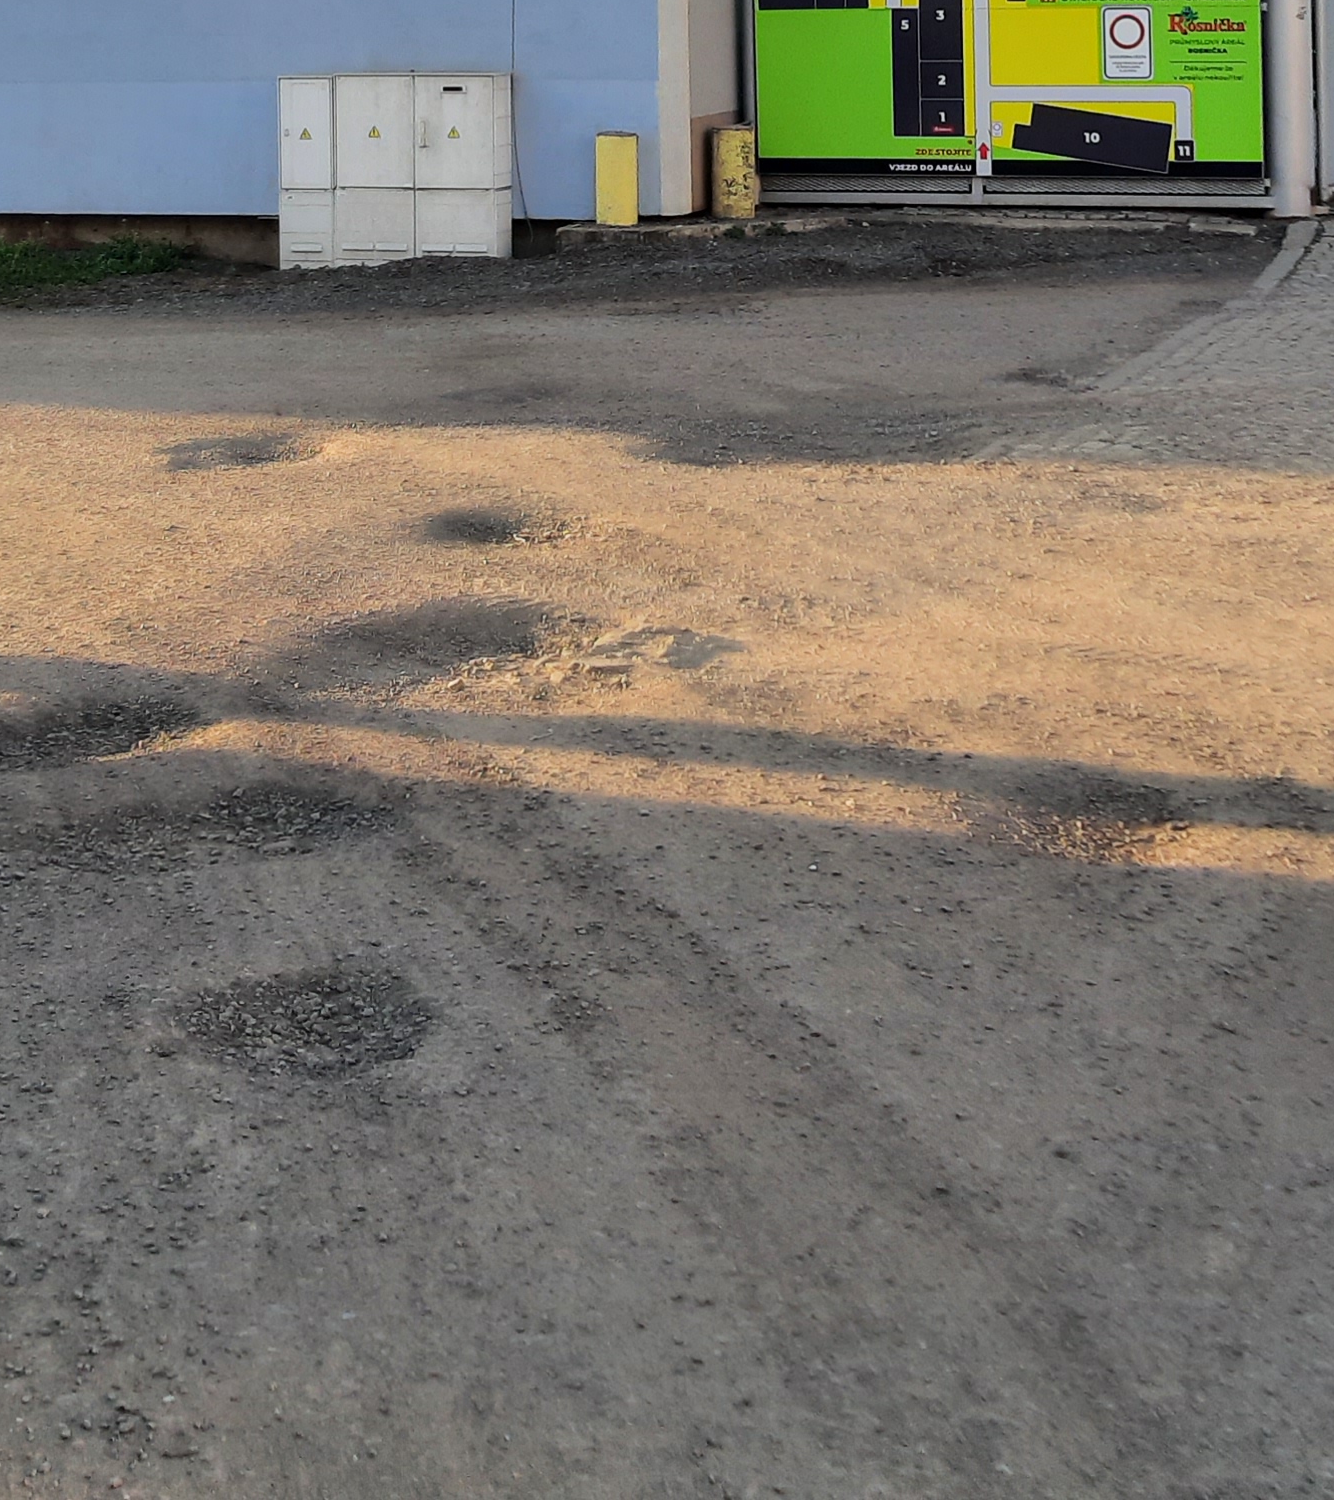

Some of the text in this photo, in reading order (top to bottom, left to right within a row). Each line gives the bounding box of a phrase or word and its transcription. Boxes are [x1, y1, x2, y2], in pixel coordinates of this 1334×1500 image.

[935, 9, 945, 21] 3
[900, 19, 909, 30] 5
[937, 75, 947, 86] 2
[938, 111, 946, 123] 1
[1083, 131, 1101, 144] 10
[1177, 145, 1191, 157] 11
[920, 163, 934, 172] DO
